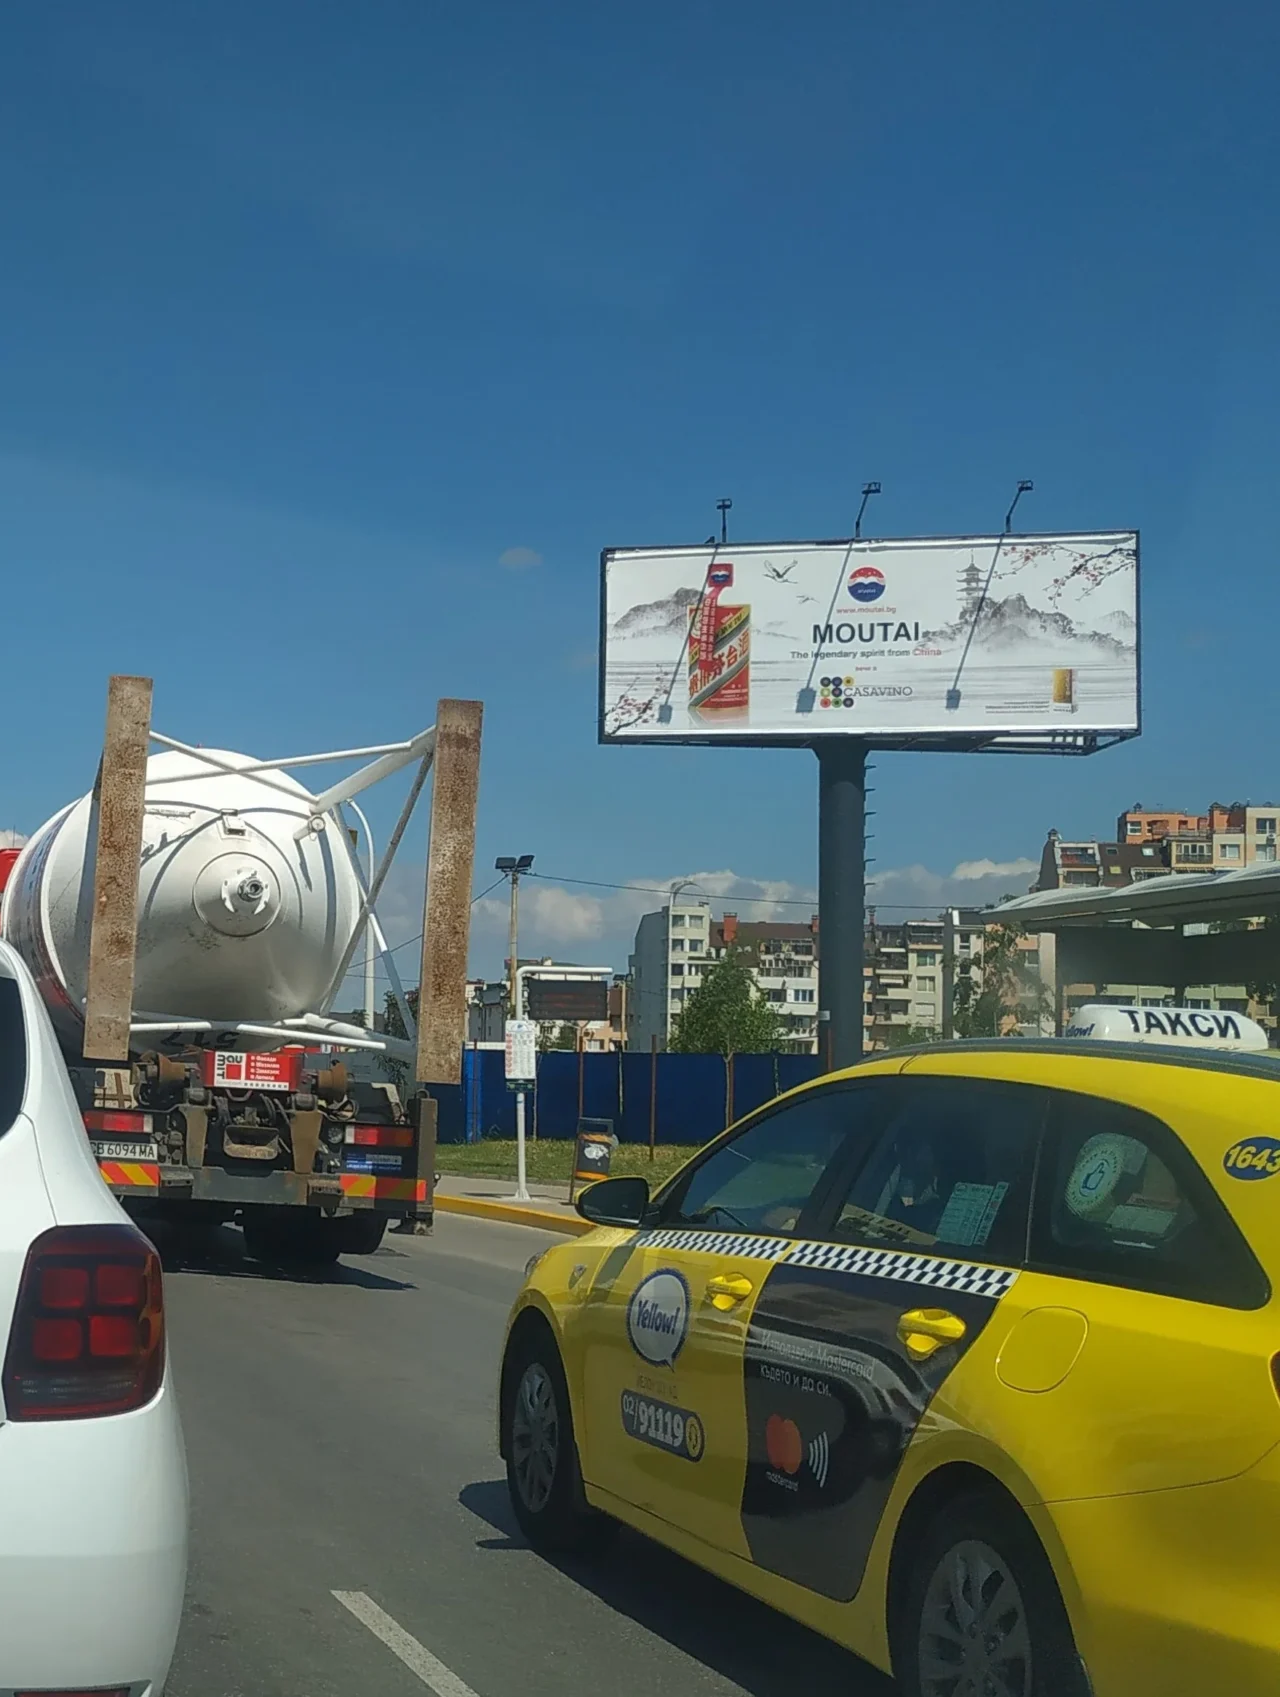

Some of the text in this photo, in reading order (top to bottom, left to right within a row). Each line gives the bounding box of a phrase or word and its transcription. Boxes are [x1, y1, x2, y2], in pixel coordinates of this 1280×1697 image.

[812, 621, 920, 644] MOUTAI
[790, 647, 942, 660] The legendary spirit from China
[843, 686, 913, 697] CASAVINO
[1118, 1009, 1241, 1040] ТАКСИ
[636, 1299, 681, 1336] Yellow!
